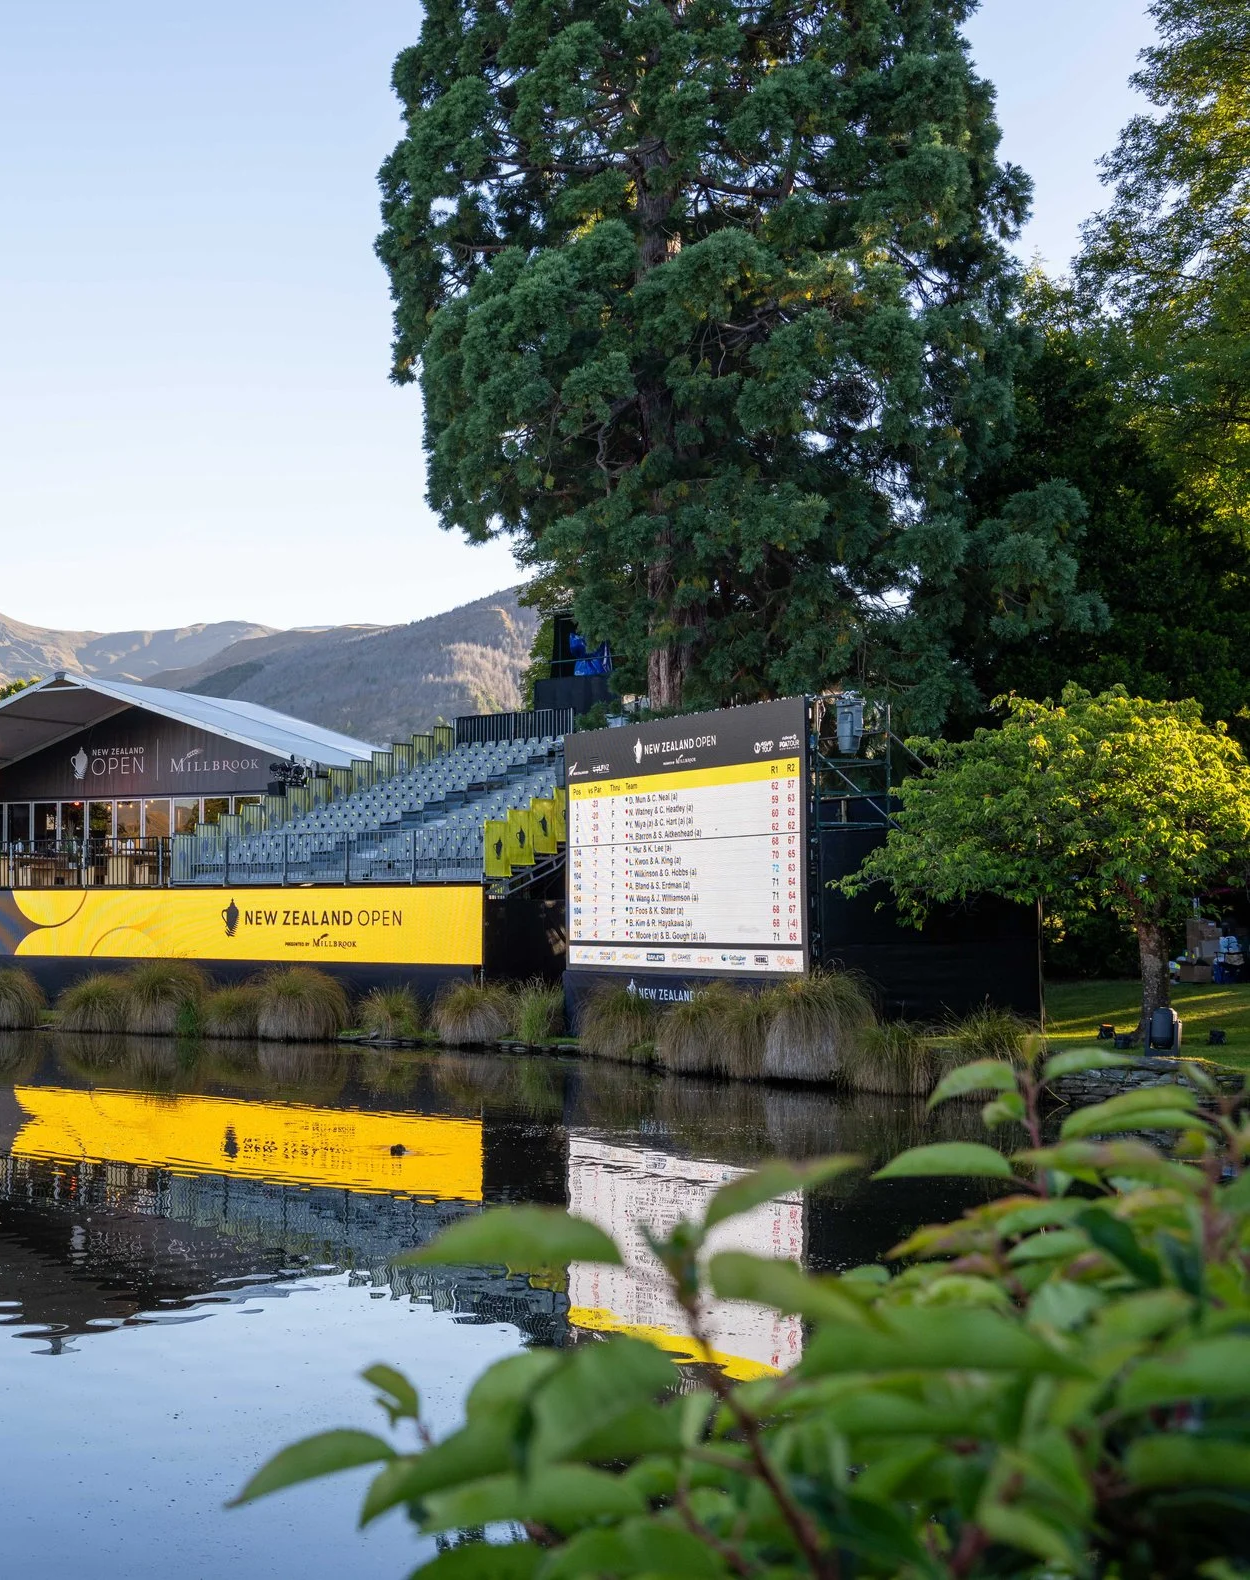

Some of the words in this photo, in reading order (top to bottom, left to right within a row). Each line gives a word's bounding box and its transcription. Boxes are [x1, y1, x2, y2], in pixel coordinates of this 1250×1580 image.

[644, 743, 660, 755] NEW
[662, 738, 694, 752] ZEALAND
[695, 735, 716, 748] OPEN
[111, 747, 144, 755] ZEALAND
[91, 756, 144, 776] OPEN
[170, 758, 259, 774] MILLBROOK
[771, 766, 778, 774] R1
[787, 764, 794, 772] R2
[772, 782, 778, 790] 62
[788, 780, 794, 788] 57
[772, 795, 778, 804] 59
[788, 794, 795, 802] 63
[788, 808, 795, 816] 62
[772, 822, 779, 831] 62
[788, 821, 795, 830] 62
[772, 836, 779, 845] 68
[788, 836, 795, 844] 67
[772, 850, 779, 859] 70
[788, 850, 795, 858] 65
[661, 856, 673, 866] King
[634, 869, 658, 877] Wilkinson
[672, 868, 688, 876] Hobbs
[772, 864, 779, 872] 72
[788, 864, 795, 872] 63
[772, 878, 779, 886] 71
[788, 877, 795, 886] 64
[636, 894, 650, 904] Wang
[772, 891, 779, 900] 71
[789, 891, 796, 900] 64
[773, 905, 780, 913] 68
[789, 905, 796, 913] 67
[245, 910, 278, 926] NEW
[282, 910, 352, 926] ZEALAND
[357, 910, 402, 926] OPEN
[658, 919, 684, 928] Hayakawa
[773, 919, 780, 927] 68
[788, 918, 798, 929] (-4)
[636, 931, 651, 939] Moore
[672, 931, 690, 941] Gough
[773, 932, 780, 941] 71
[789, 932, 797, 941] 65
[312, 938, 357, 949] MILLBROOK
[639, 988, 656, 1000] NEW
[659, 989, 695, 1002] ZEALAND
